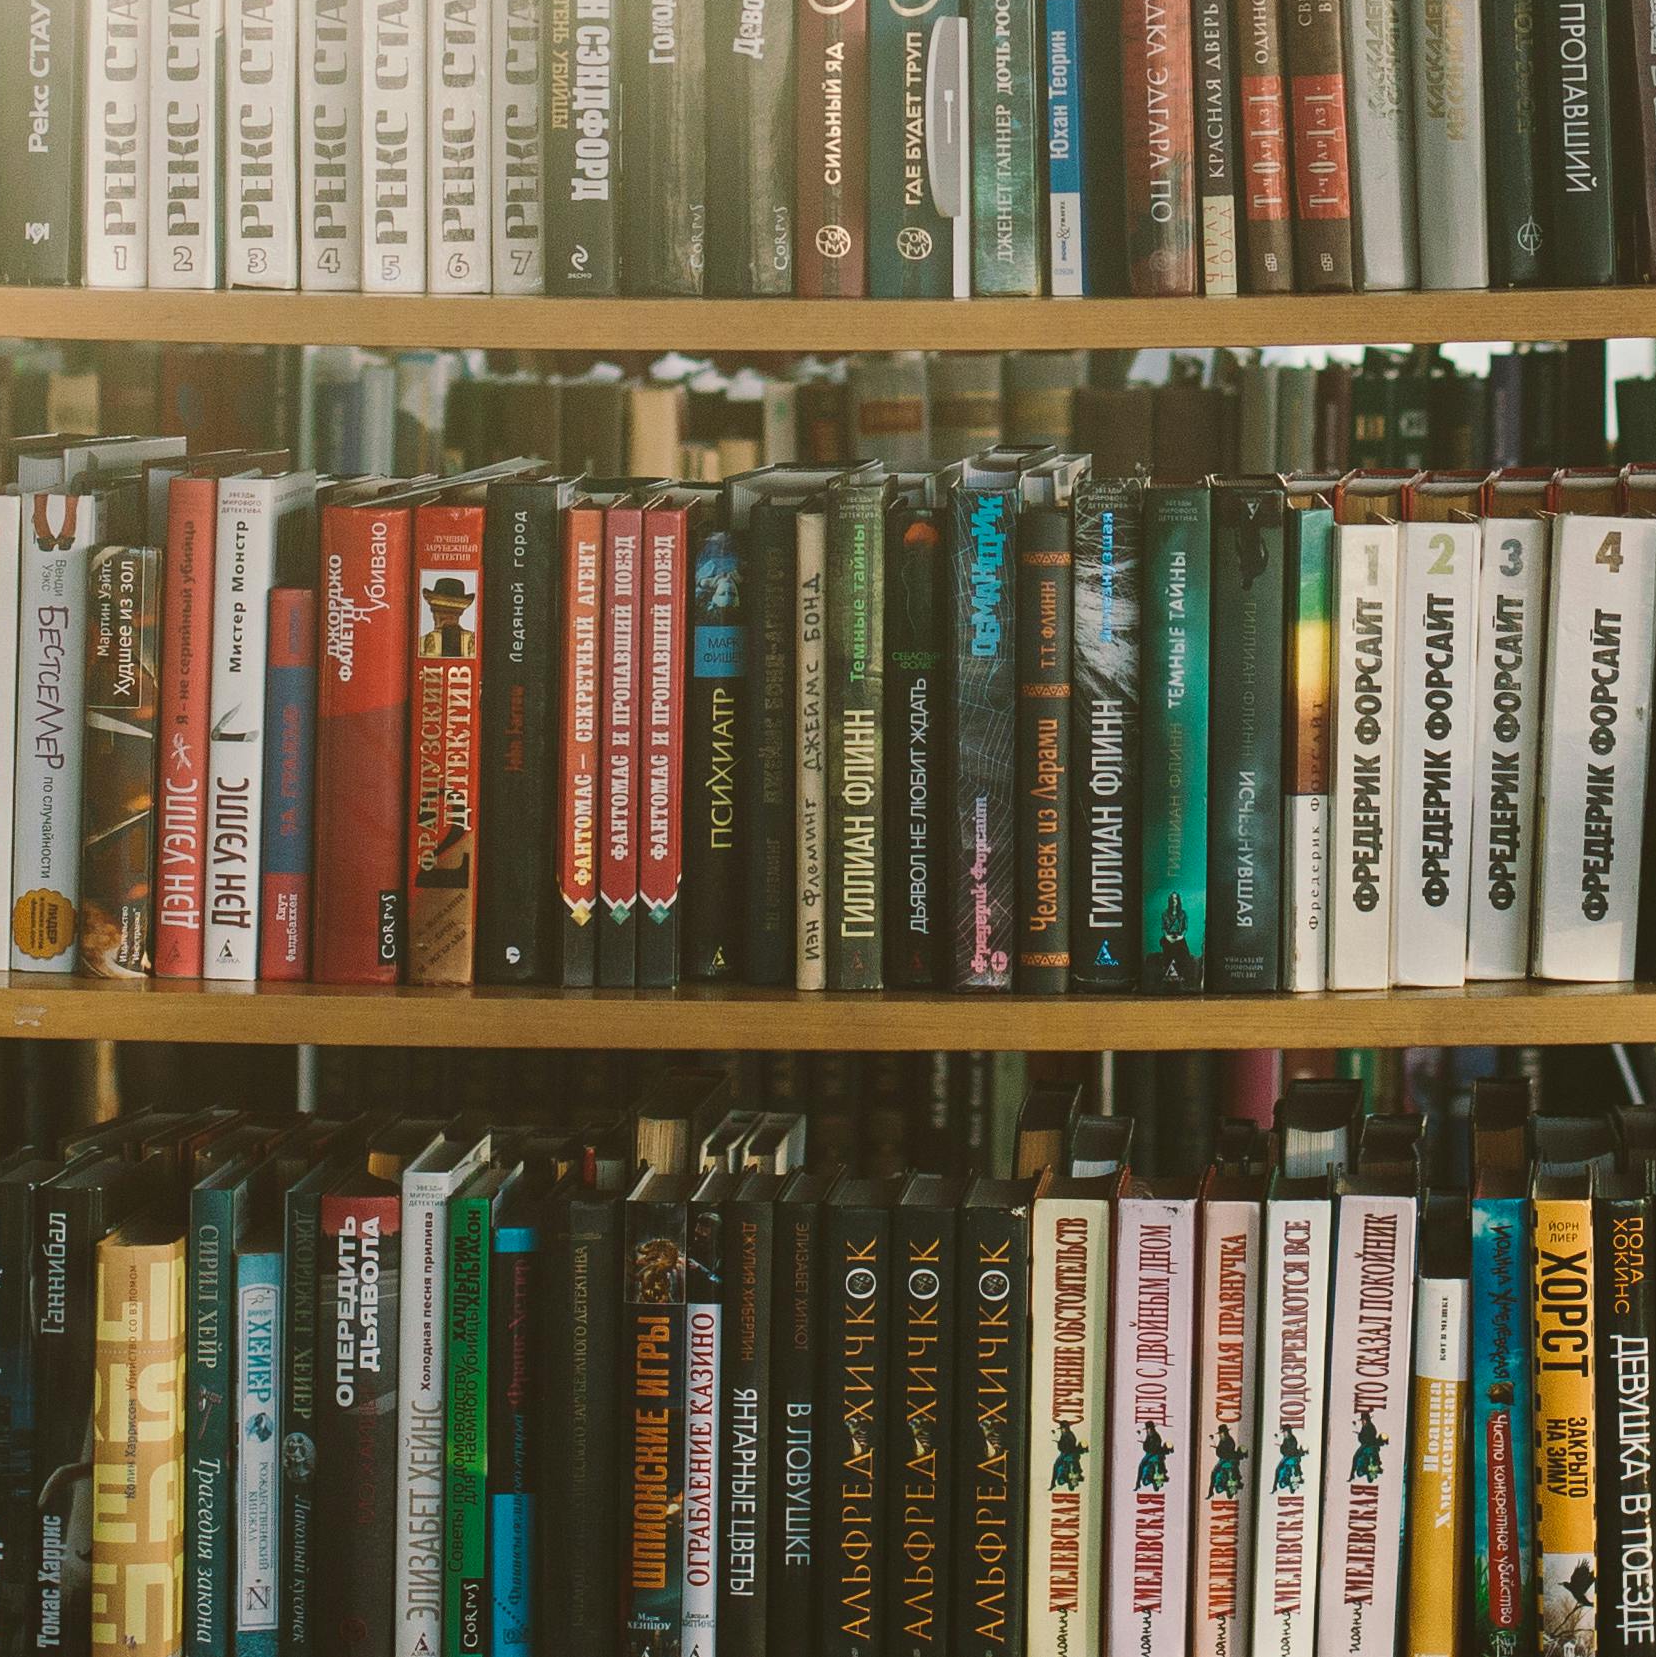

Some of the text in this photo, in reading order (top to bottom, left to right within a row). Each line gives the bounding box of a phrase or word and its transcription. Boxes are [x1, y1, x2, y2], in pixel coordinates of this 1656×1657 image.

[29, 85, 51, 152] Рекс
[239, 105, 273, 239] РЕКС
[572, 26, 611, 200] СЭНДФОРД
[822, 42, 843, 184] СИЛЬНЫЙ ЯД
[906, 32, 923, 204] ГДЕ БУДЕТ ТРУП
[1204, 3, 1225, 178] КРАСНАЯ ДВЕРЬ
[1559, 3, 1597, 192] ПРОПАВШИЙ
[247, 248, 267, 274] 3
[114, 561, 134, 696] Худшее из зол
[327, 554, 345, 659] ДЖОРДЖО
[368, 522, 391, 611] убиваю
[1429, 534, 1455, 575] 2
[575, 542, 596, 886] ФАНТОМАС СЕКРЕТНЫЙ АГЕНТ
[705, 688, 741, 848] ПСИХИАТР
[1352, 598, 1383, 913] ФРЕДЕРИК ФОРСАЙТ
[1422, 593, 1454, 907] ФРЕДЕРИК ФОРСАЙТ
[841, 710, 875, 937] ГИЛЛИАН ФЛИНН
[910, 679, 928, 934] ДЬЯВОЛ НЕ ЛЮБИТ ЖДАТЬ
[336, 1217, 359, 1407] ОПЕРЕДИТЬ
[360, 1217, 382, 1373] ДЬЯВОЛА
[419, 1212, 435, 1392] Холодная песня прилива
[1215, 1234, 1246, 1423] СТАРШАЯ ПРАВНУЧКА
[1541, 1250, 1589, 1377] ХОРСТ
[1629, 1218, 1644, 1281] ПОЛА
[405, 1400, 442, 1620] ЭЛИЗАБЕТ ХЕЙНС
[726, 1388, 757, 1597] ЯНТАРНЫЕ ЦВЕТЫ
[787, 1404, 811, 1565] В ЛОВУШКЕ
[842, 1237, 876, 1639] АЛЬФРЕД ХИЧКОК
[1567, 1417, 1589, 1498] ЗАКРЫТО
